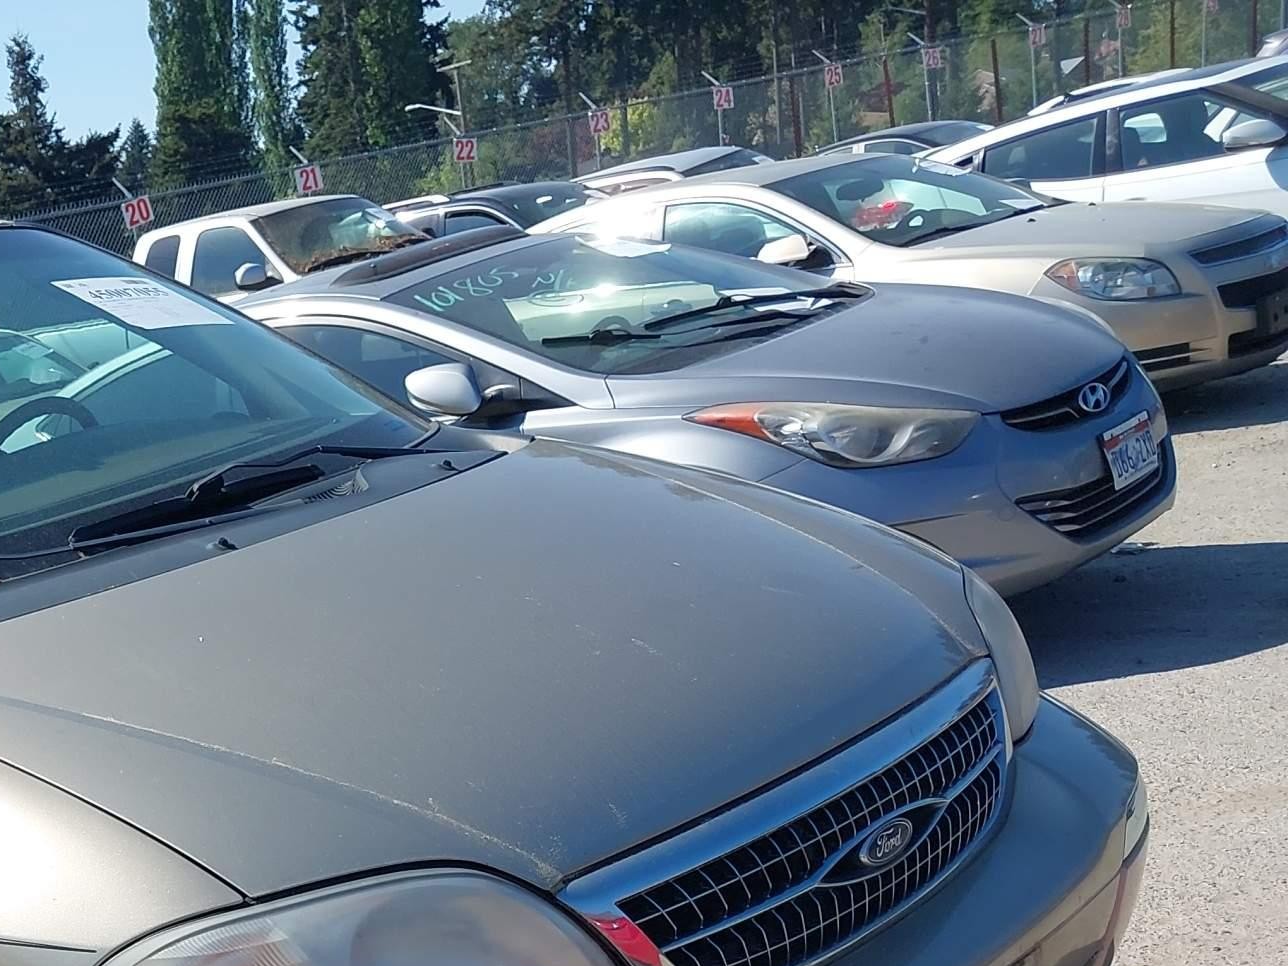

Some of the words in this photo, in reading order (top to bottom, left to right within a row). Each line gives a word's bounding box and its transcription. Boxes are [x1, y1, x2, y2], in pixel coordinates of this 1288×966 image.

[827, 66, 841, 85] 25
[715, 88, 731, 107] 24
[591, 111, 610, 133] 23
[455, 139, 475, 161] 22
[299, 167, 319, 191] 21
[125, 198, 150, 227] 20
[876, 827, 902, 858] Ford
